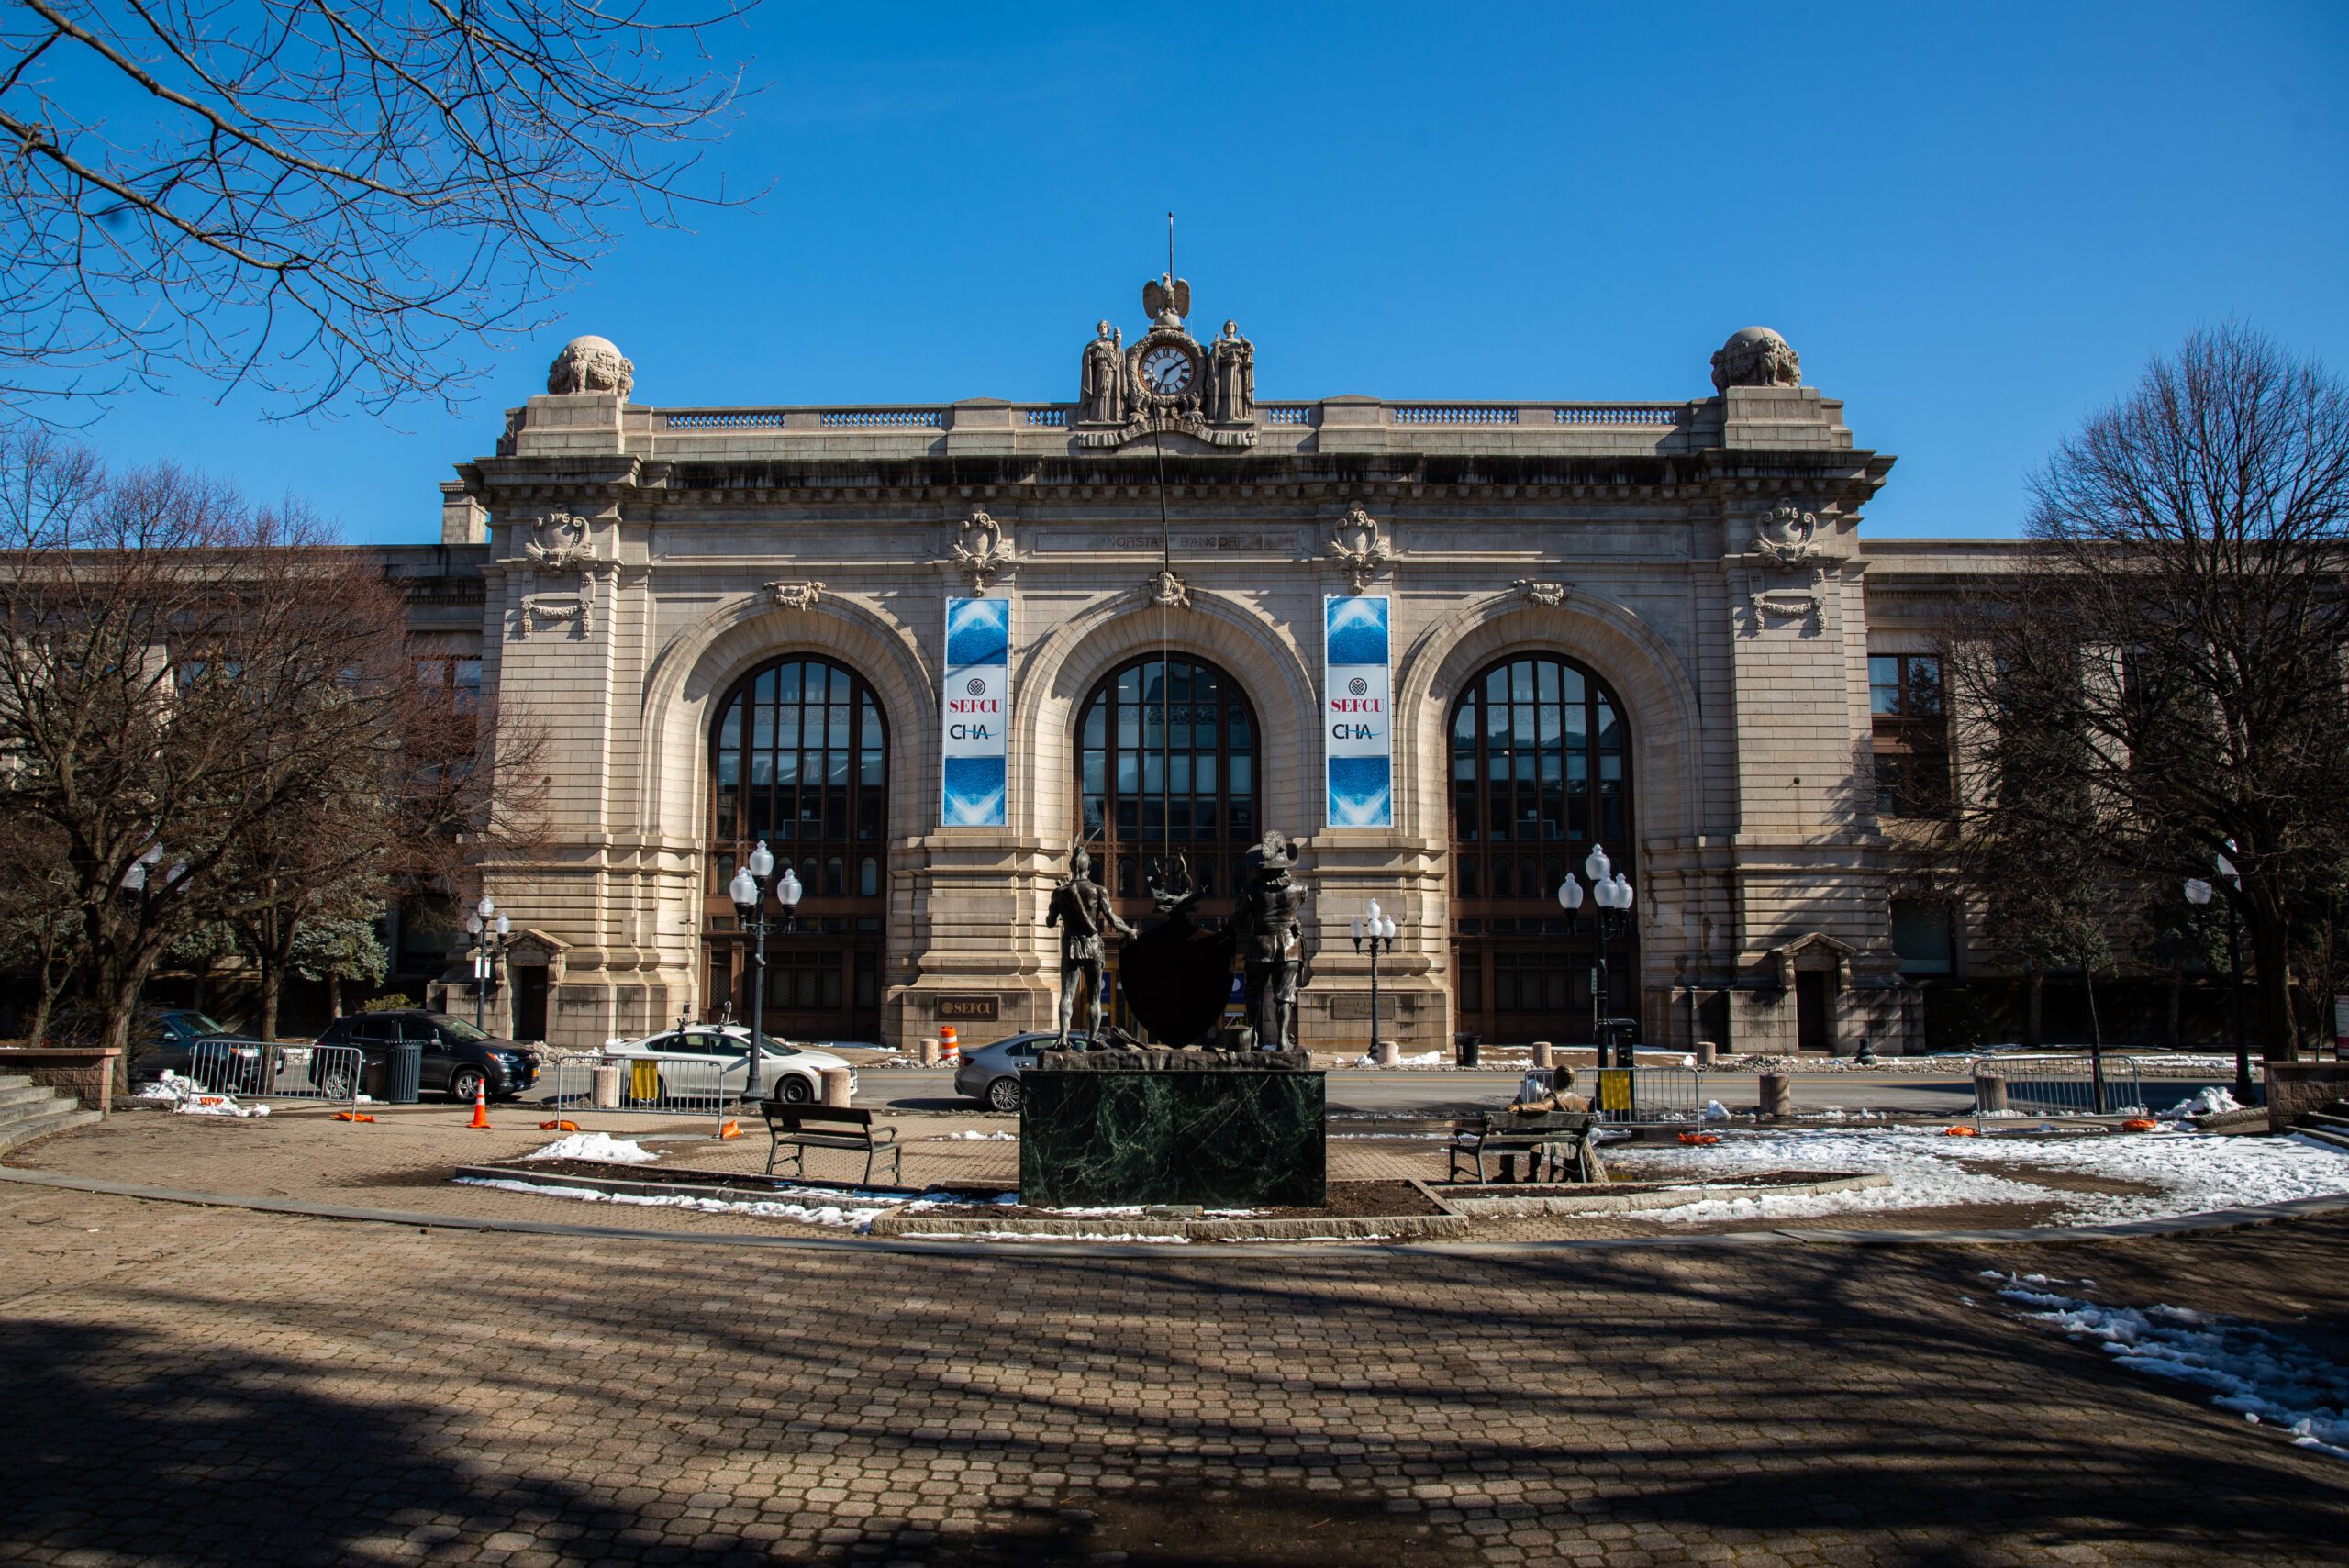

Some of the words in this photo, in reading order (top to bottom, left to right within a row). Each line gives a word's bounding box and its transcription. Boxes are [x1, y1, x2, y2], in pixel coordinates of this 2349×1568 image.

[949, 699, 1003, 713] SEFCU
[1330, 699, 1386, 713] SEFCU
[950, 724, 989, 740] CHA
[1332, 724, 1373, 740] CHA
[953, 1002, 994, 1014] SEFCU
